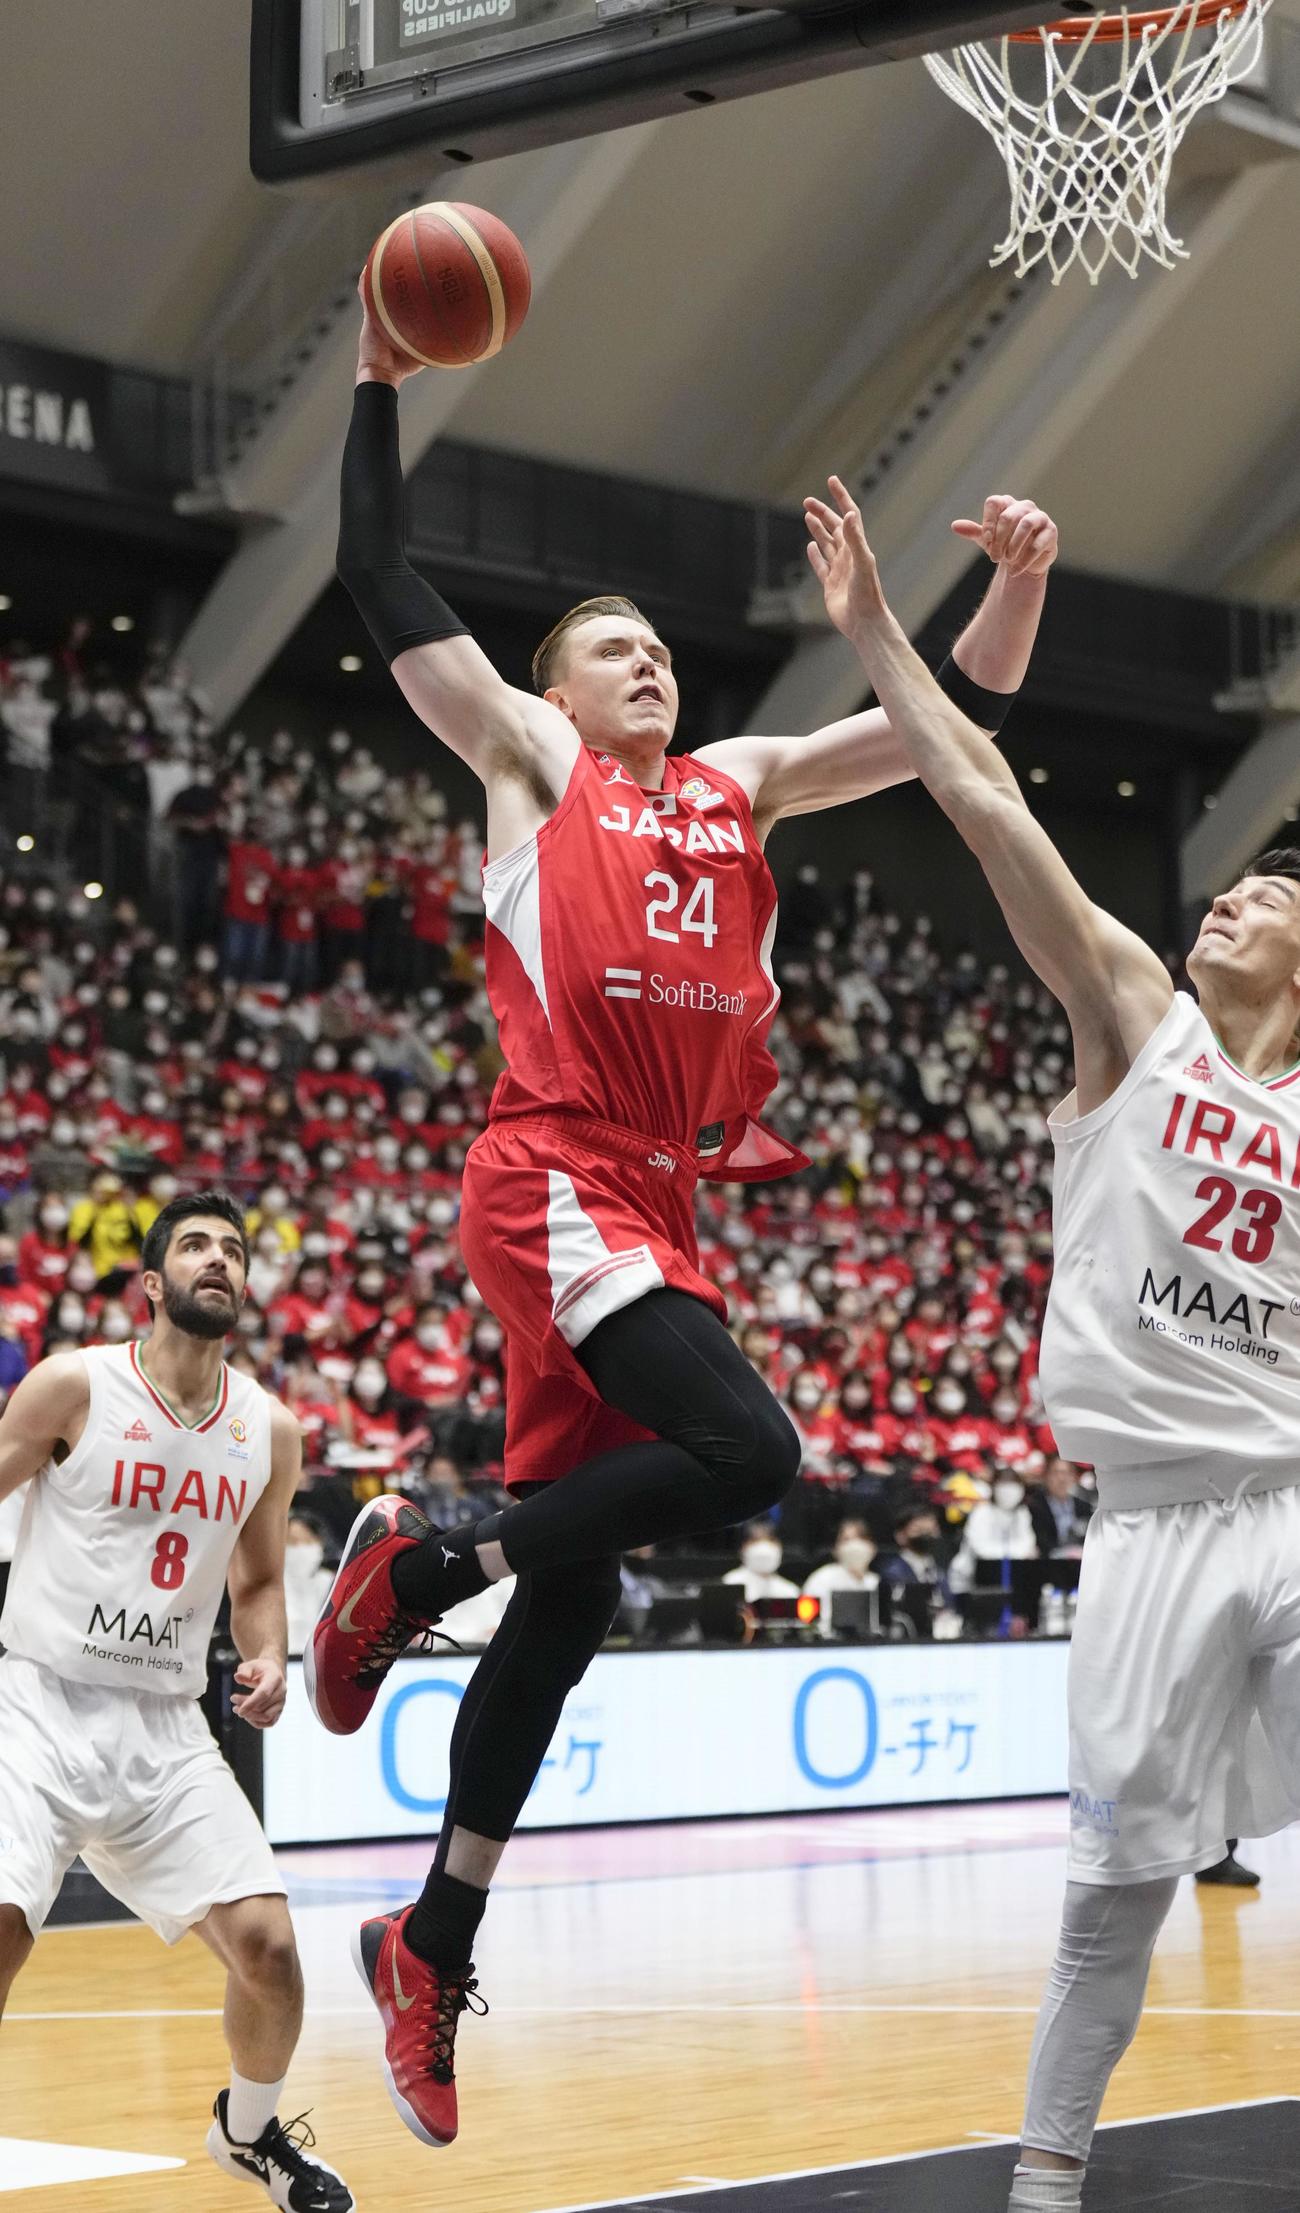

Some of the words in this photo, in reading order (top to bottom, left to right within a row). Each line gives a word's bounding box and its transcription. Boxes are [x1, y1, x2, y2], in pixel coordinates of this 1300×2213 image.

[0, 383, 95, 453] ENA
[599, 805, 746, 854] JAPAN
[644, 870, 718, 948] 24
[649, 973, 748, 1016] SoftBank
[648, 1152, 676, 1174] JPN
[1182, 1176, 1283, 1265] 23
[1138, 1267, 1285, 1340] MAAT
[1138, 1315, 1204, 1347] Macom
[1211, 1333, 1279, 1365] Holding
[111, 1459, 248, 1526] IRAN
[151, 1531, 189, 1591] 8
[87, 1603, 183, 1649] MAAT
[82, 1643, 144, 1667] Marcom
[147, 1655, 184, 1674] Holding
